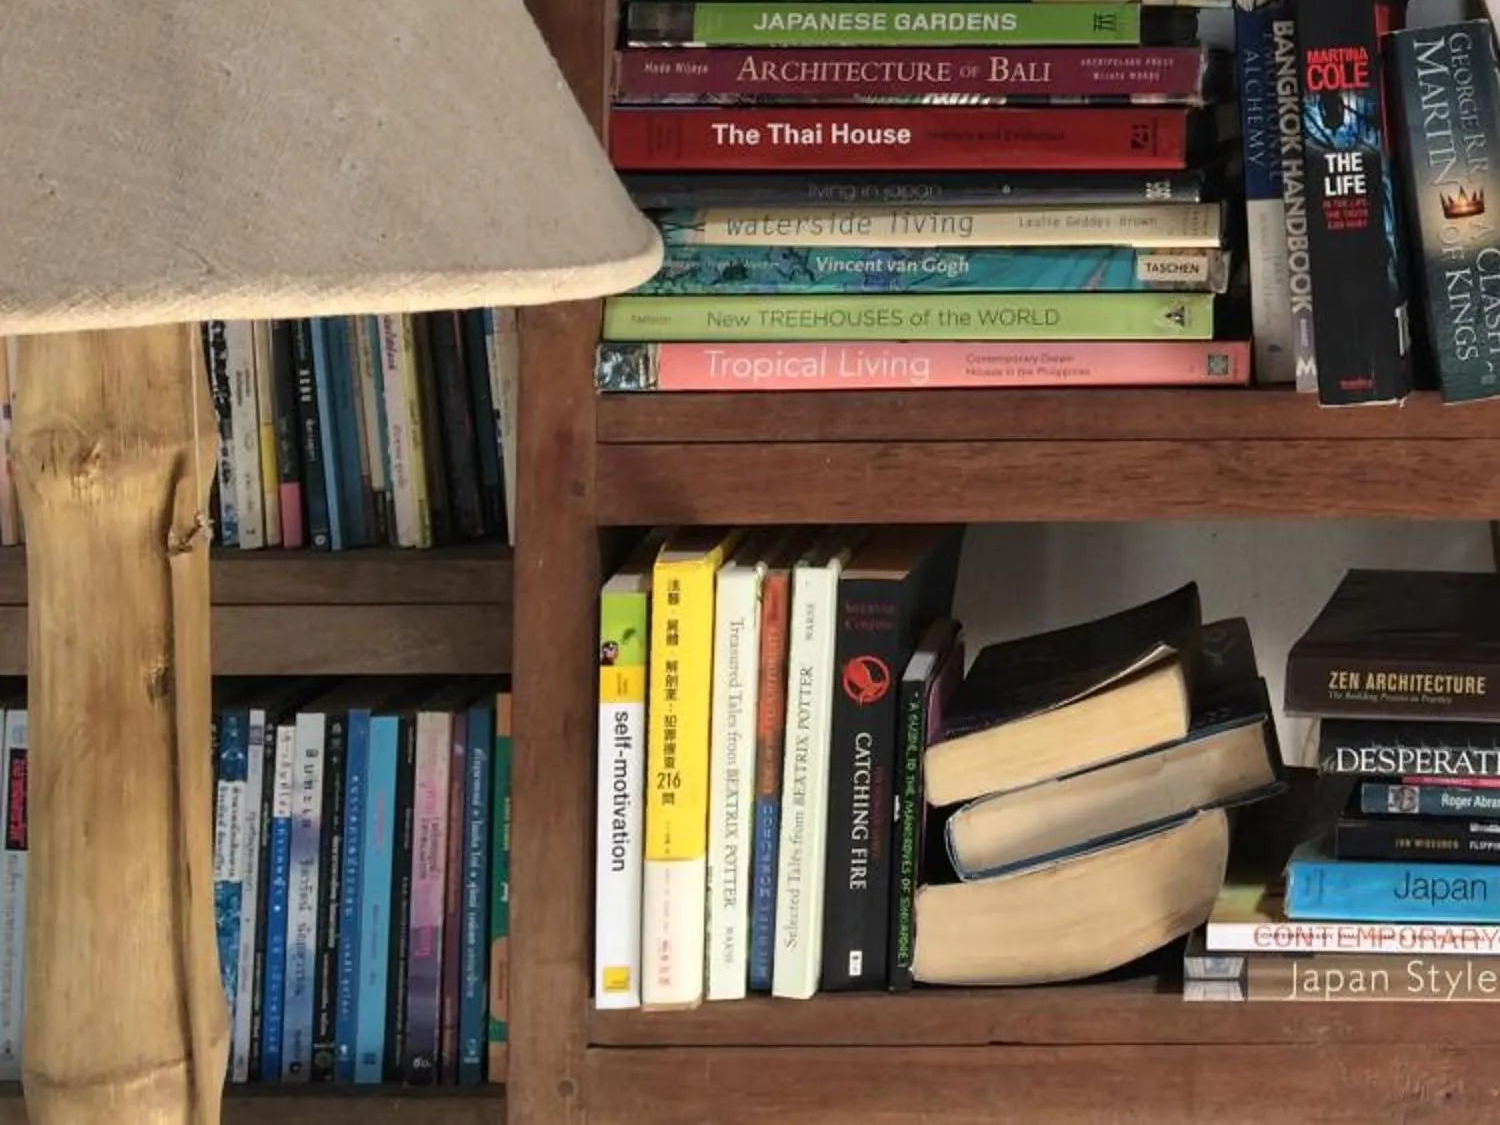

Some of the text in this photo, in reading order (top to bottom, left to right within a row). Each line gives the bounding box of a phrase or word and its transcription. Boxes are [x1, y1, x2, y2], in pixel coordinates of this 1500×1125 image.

[753, 12, 1017, 32] JAPANESE GARDENS
[737, 55, 952, 82] ARCHITECTURE
[988, 56, 1052, 82] BALI
[1307, 47, 1368, 64] MARTINA
[1272, 20, 1301, 153] BANGKOK
[1307, 62, 1370, 92] COLE
[1450, 32, 1482, 133] GEORGE
[1243, 47, 1265, 168] ALCHEMY
[1413, 35, 1460, 187] MARTIN
[712, 122, 760, 145] The
[767, 122, 823, 145] Thai
[830, 123, 911, 145] House
[1324, 152, 1364, 174] THE
[1324, 175, 1368, 197] LIFE
[726, 209, 974, 237] waterside living
[1281, 158, 1313, 314] HANDBOOK
[816, 256, 969, 278] Vincent van Gogh
[1145, 262, 1200, 275] TASCHEN
[1439, 225, 1479, 362] OF KINGS
[707, 308, 1061, 327] New TREEHOUSES of the WORLD
[704, 348, 930, 384] Tropical Living
[797, 665, 814, 731] POTTER
[1328, 671, 1487, 695] ZEN ARCHITECTURE
[791, 735, 809, 808] BEATRIX
[611, 710, 633, 873] self-motivation
[724, 768, 740, 839] BEATRIX
[1441, 794, 1473, 809] Roger
[848, 731, 873, 891] CATCHING FIRE
[722, 845, 738, 909] POTTER
[1393, 870, 1488, 905] Japan
[783, 888, 800, 953] Selected
[1288, 959, 1498, 1001] Japan Style
